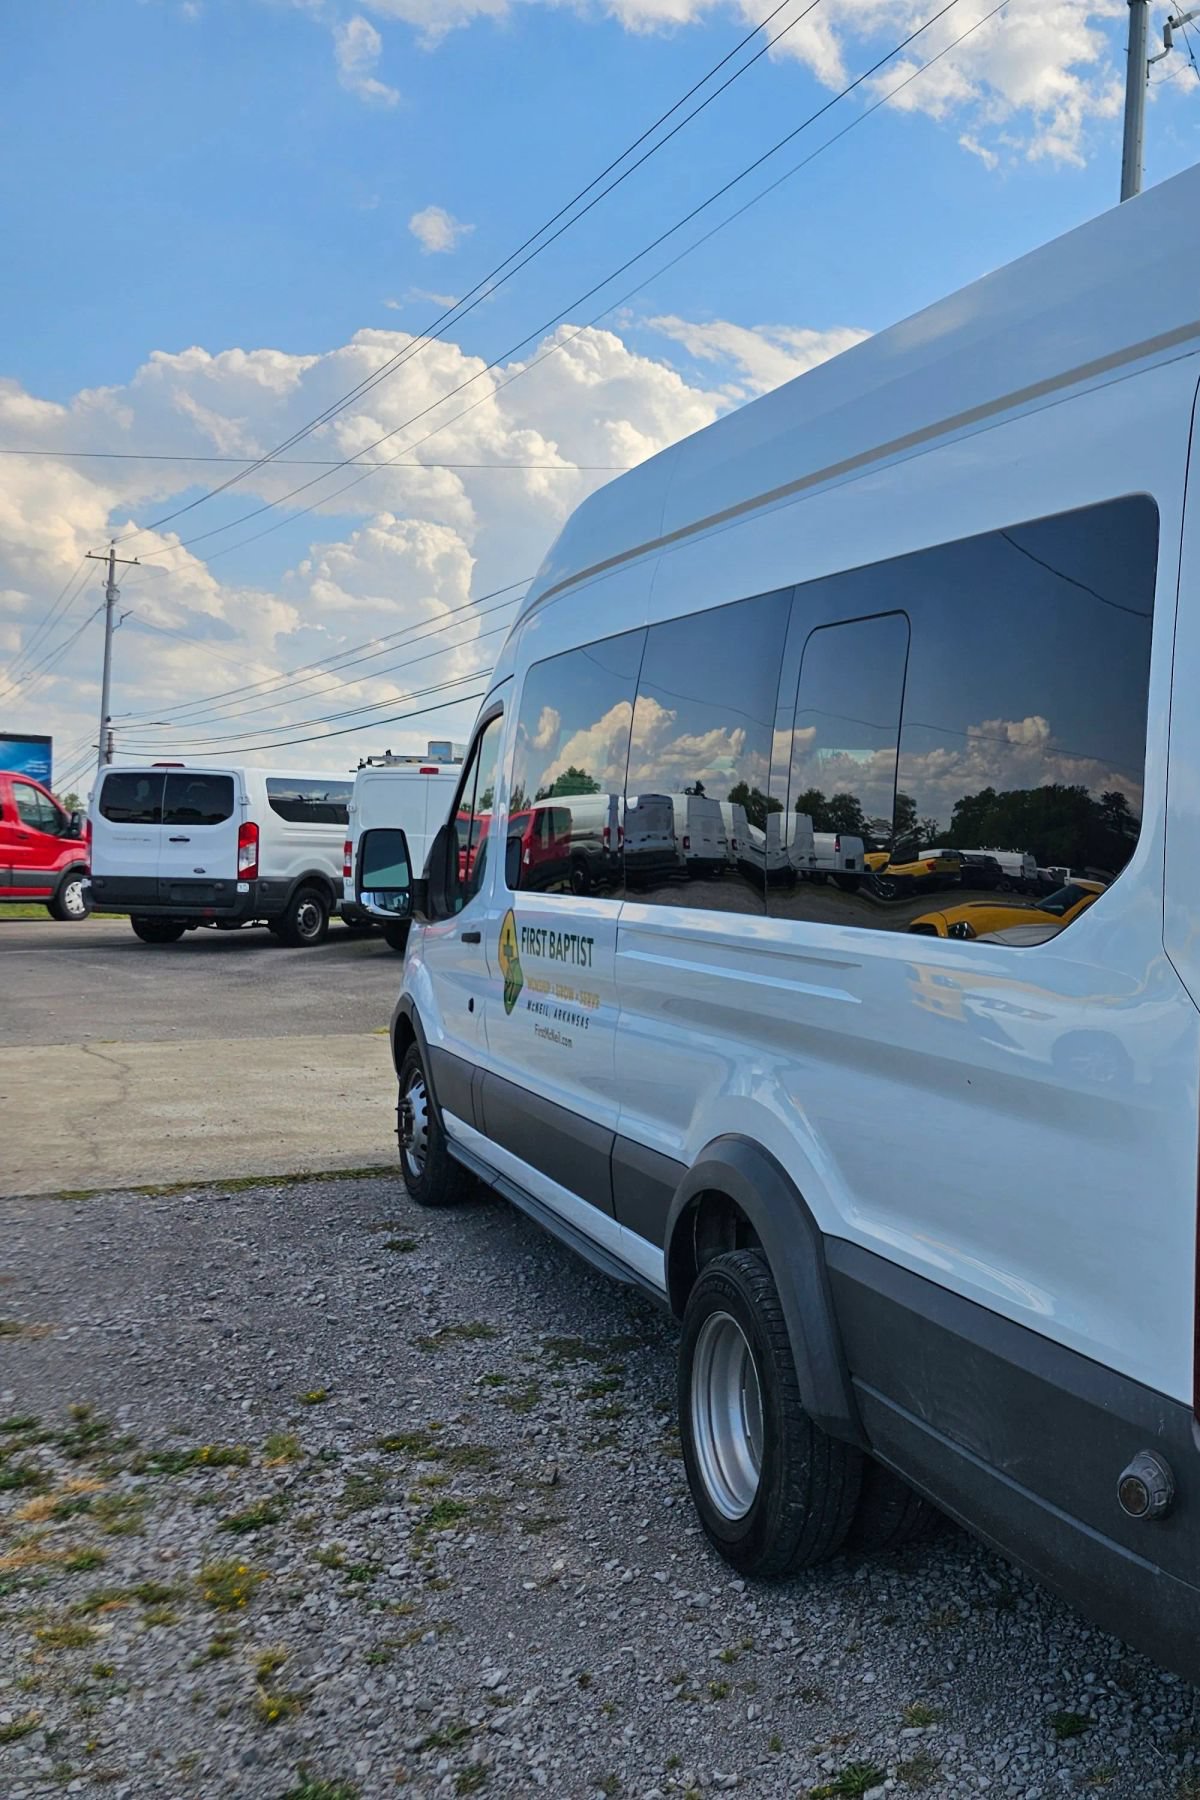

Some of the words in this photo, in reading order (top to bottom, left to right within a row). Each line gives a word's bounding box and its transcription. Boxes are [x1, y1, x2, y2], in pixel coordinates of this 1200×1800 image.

[521, 926, 547, 958] FIRST
[549, 930, 594, 968] BAPTIST
[554, 1007, 590, 1030] ARKANSAS
